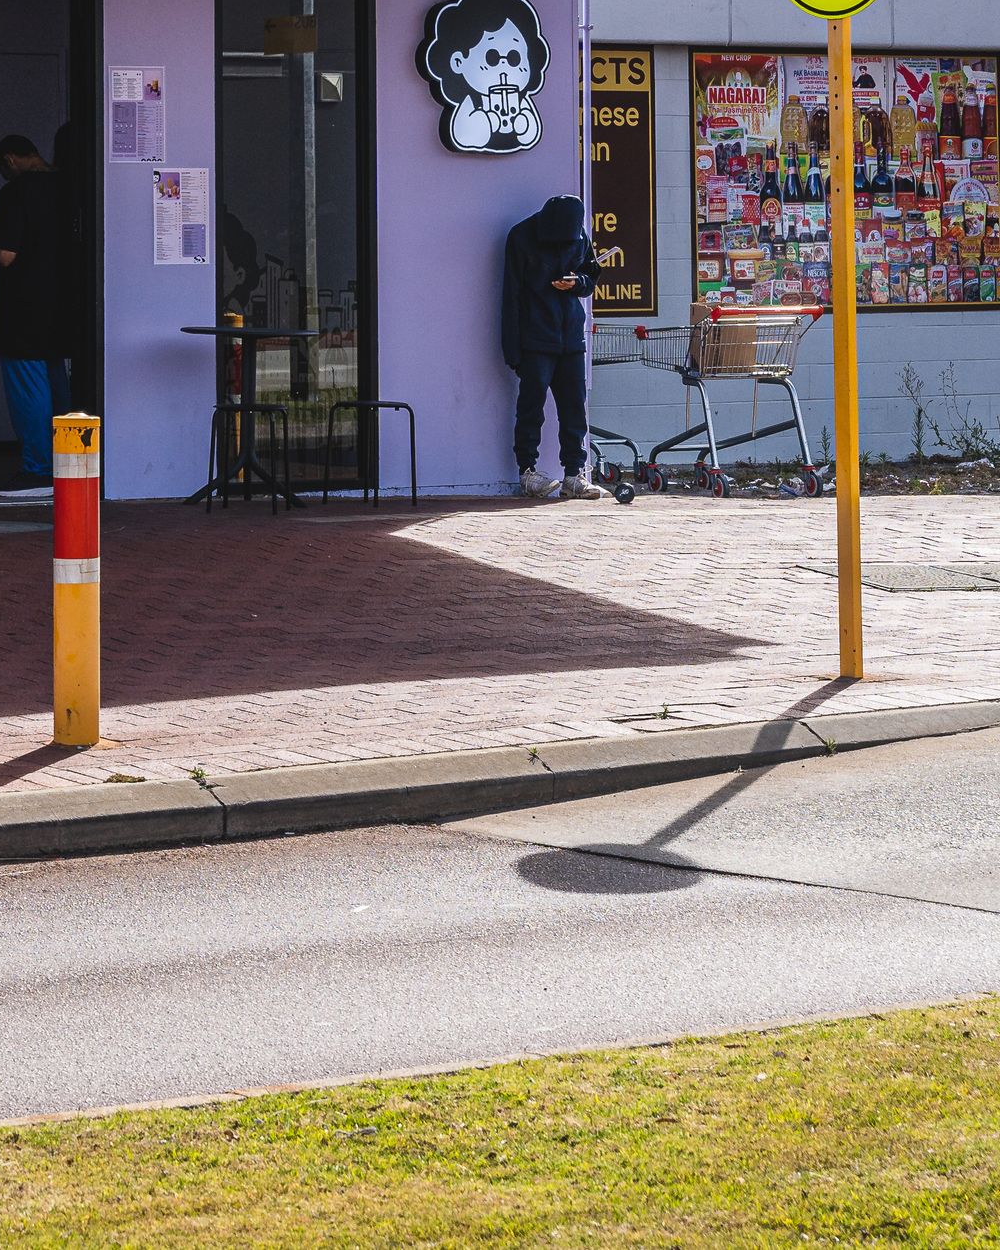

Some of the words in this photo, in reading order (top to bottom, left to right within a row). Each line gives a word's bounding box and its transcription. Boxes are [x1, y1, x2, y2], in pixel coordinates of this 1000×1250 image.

[579, 57, 646, 86] CTS
[591, 212, 618, 233] re
[594, 284, 642, 301] NLINE
